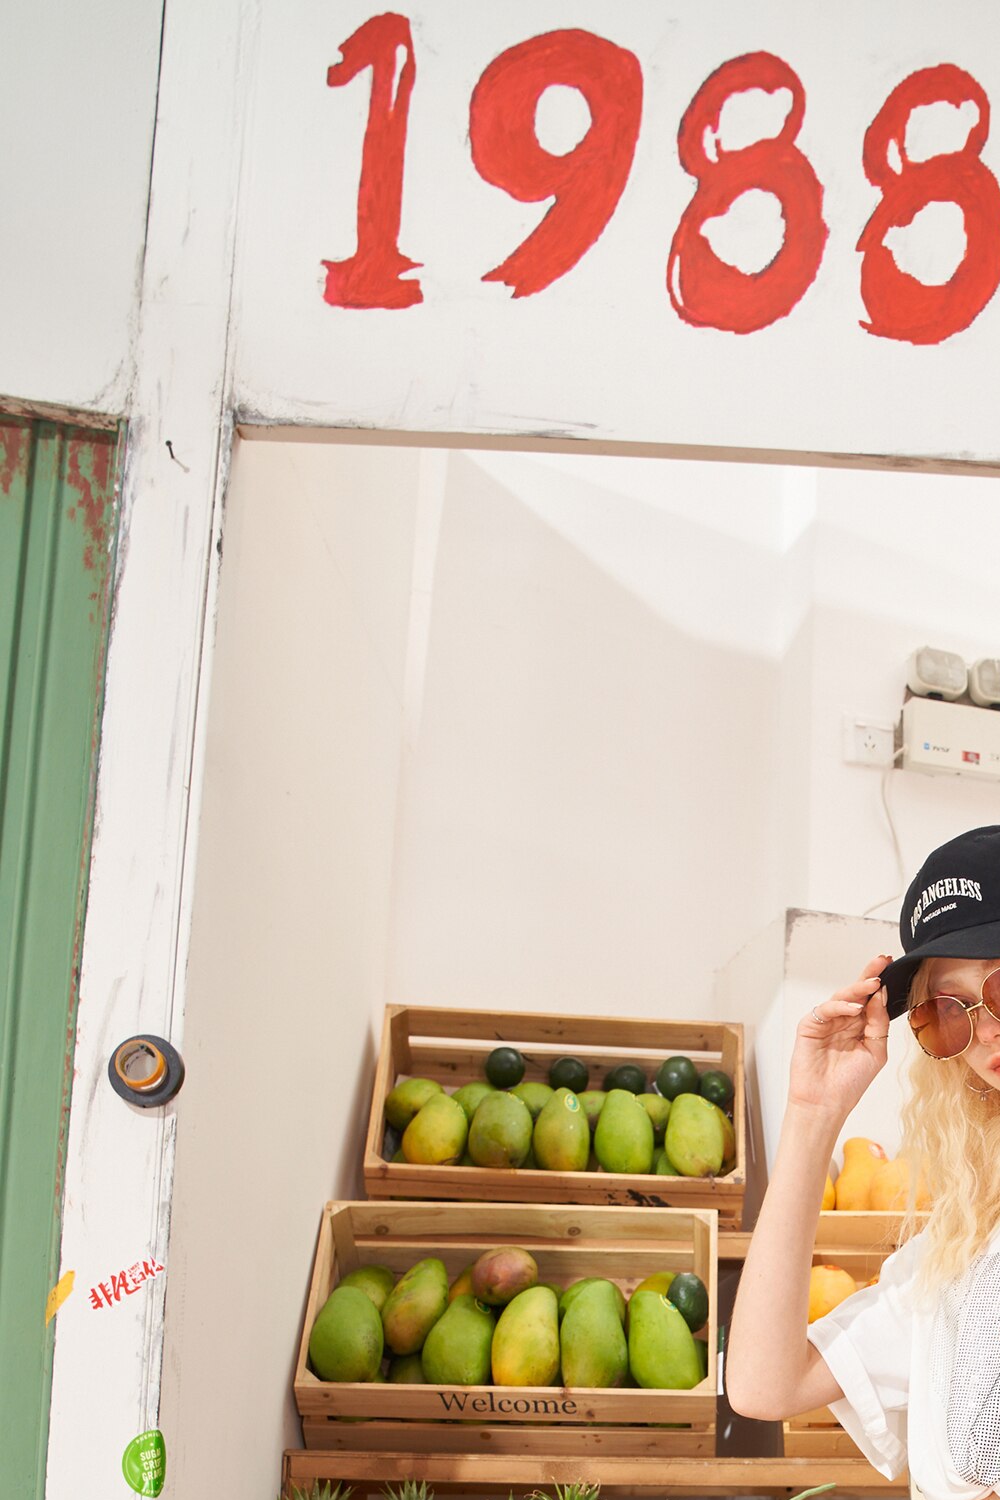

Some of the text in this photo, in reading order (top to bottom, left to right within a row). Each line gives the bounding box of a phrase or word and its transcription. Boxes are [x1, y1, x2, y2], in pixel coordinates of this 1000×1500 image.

[922, 877, 983, 911] ANGELESS
[941, 902, 958, 914] MADE
[437, 1391, 578, 1416] Welcome
